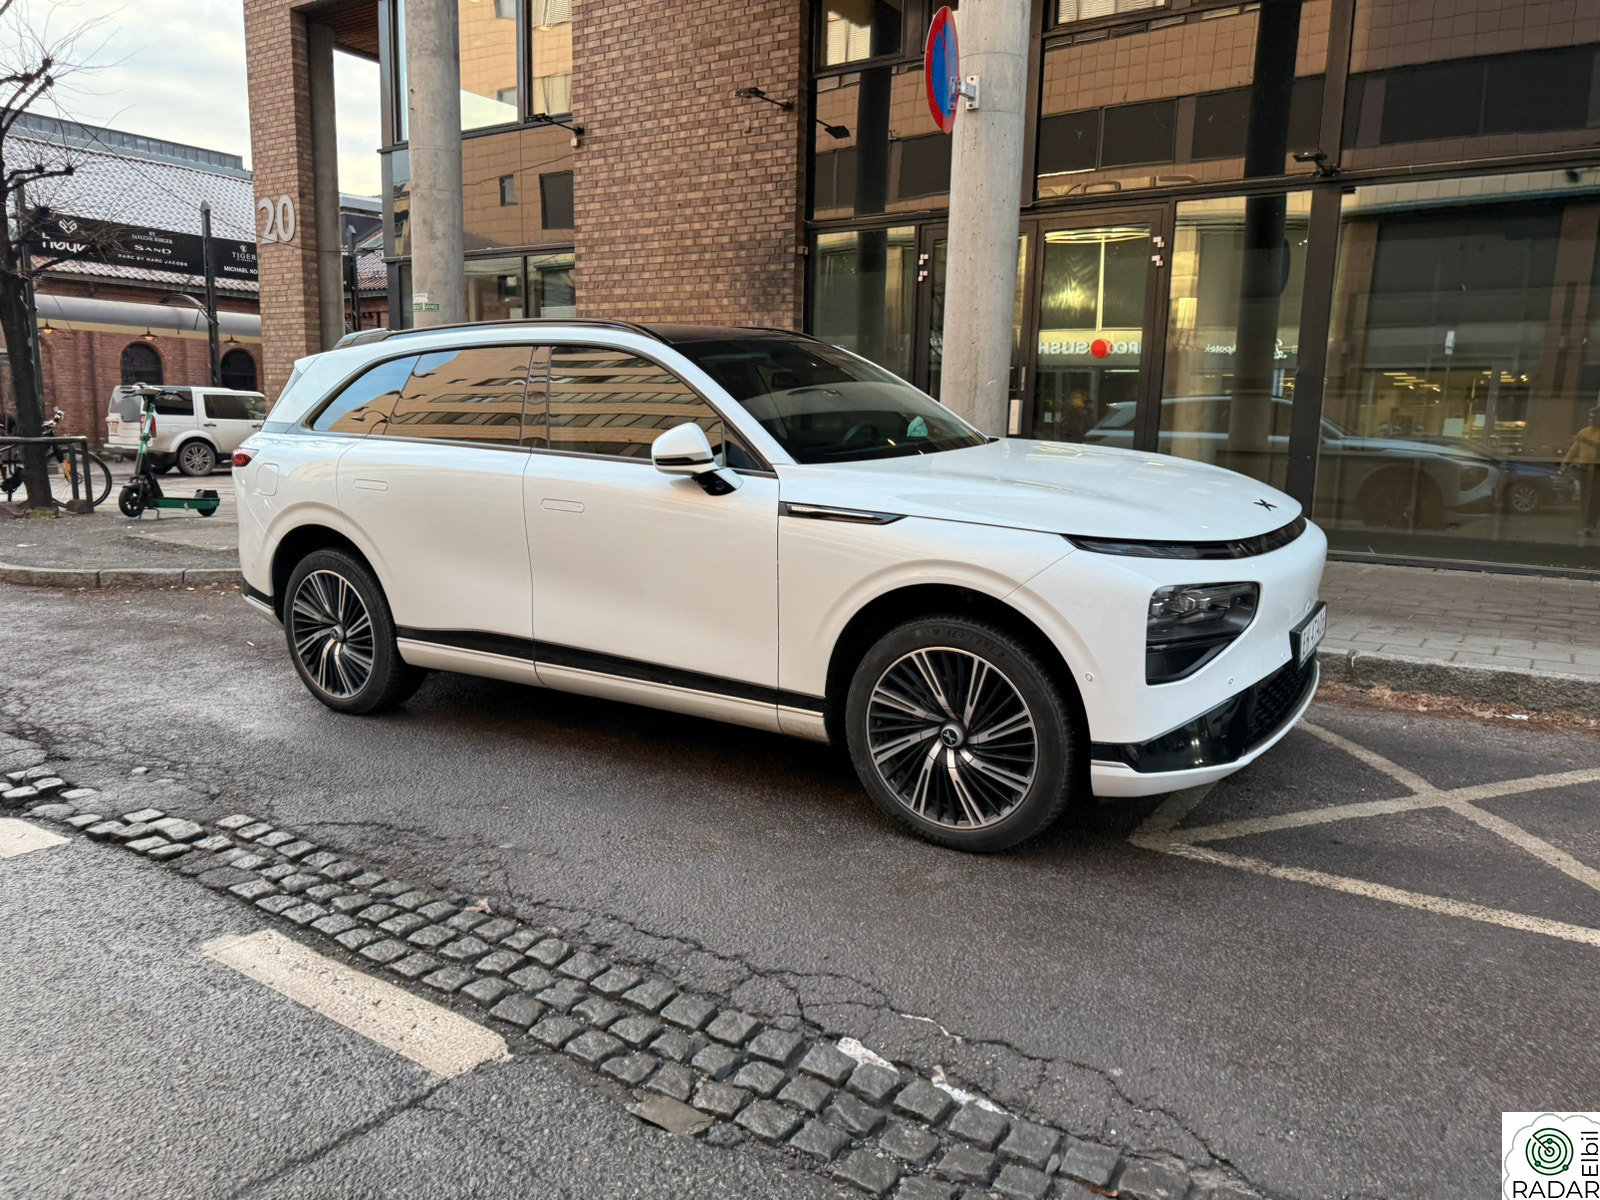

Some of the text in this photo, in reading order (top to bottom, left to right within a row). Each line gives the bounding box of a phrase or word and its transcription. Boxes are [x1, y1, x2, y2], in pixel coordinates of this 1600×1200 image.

[258, 194, 296, 244] 20
[134, 244, 172, 254] SAND
[231, 251, 257, 261] TIGER
[223, 265, 249, 274] MICHAEL
